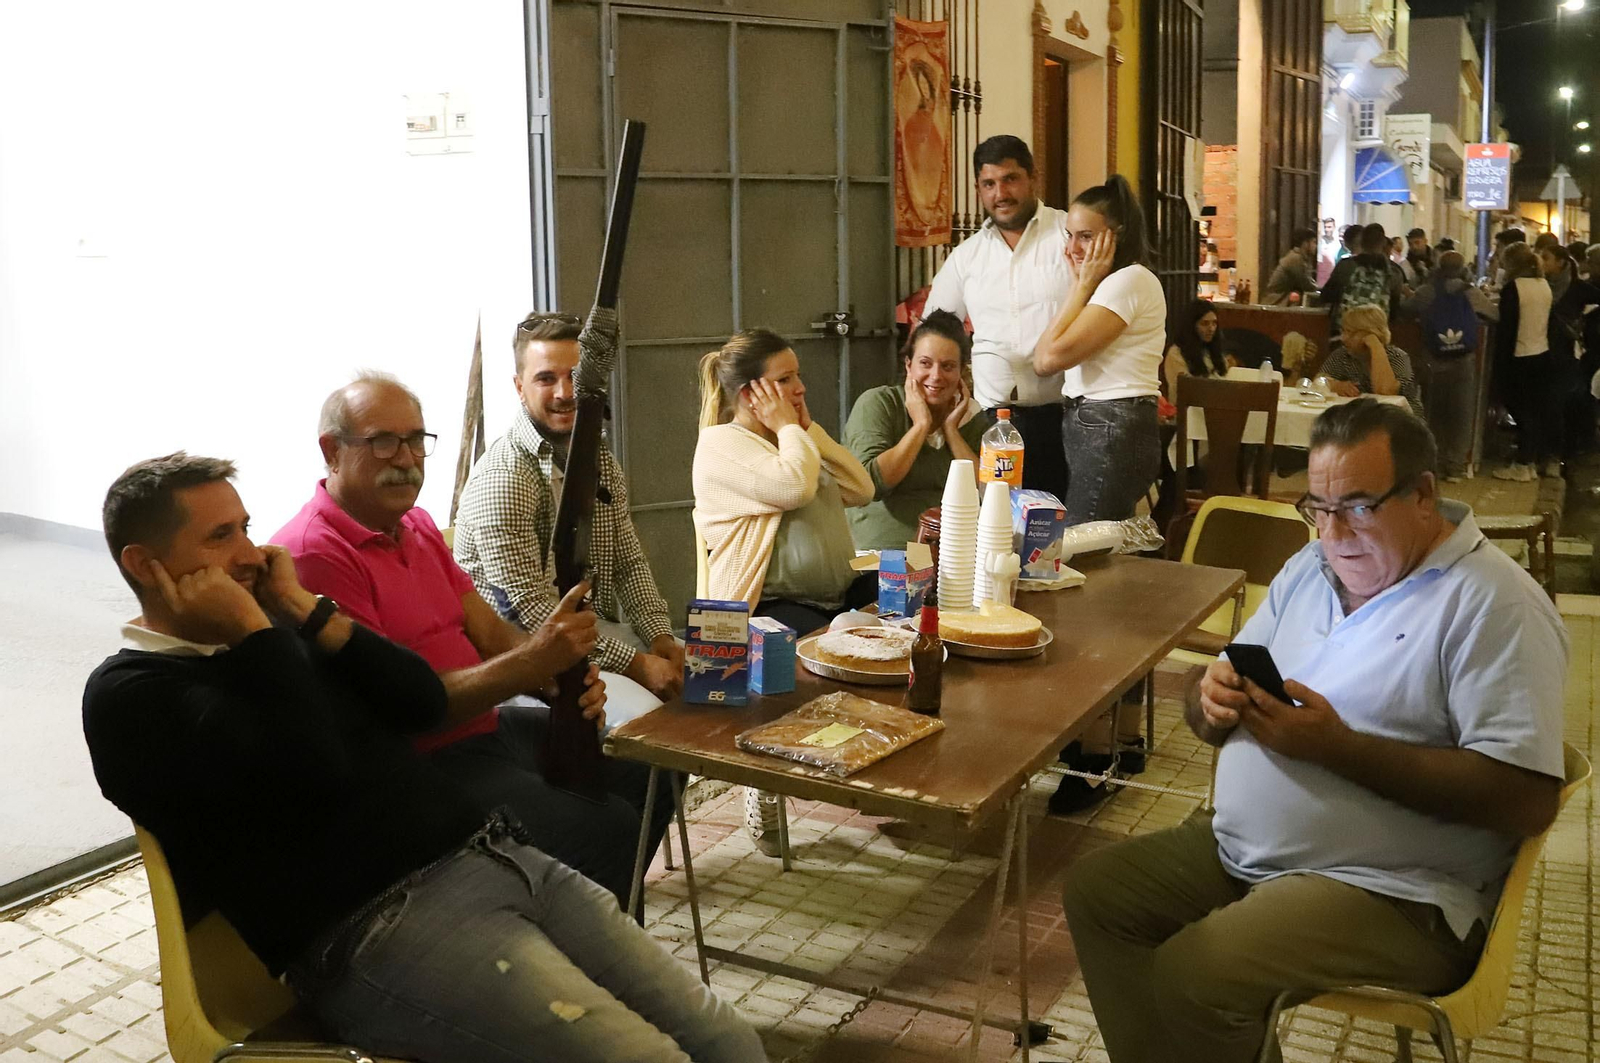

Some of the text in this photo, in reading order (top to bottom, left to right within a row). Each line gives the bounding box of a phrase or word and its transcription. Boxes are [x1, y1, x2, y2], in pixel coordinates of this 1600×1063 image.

[1029, 518, 1052, 526] Azúcar
[879, 571, 906, 581] TRAP
[687, 644, 746, 658] TRAP
[708, 691, 726, 701] EG
